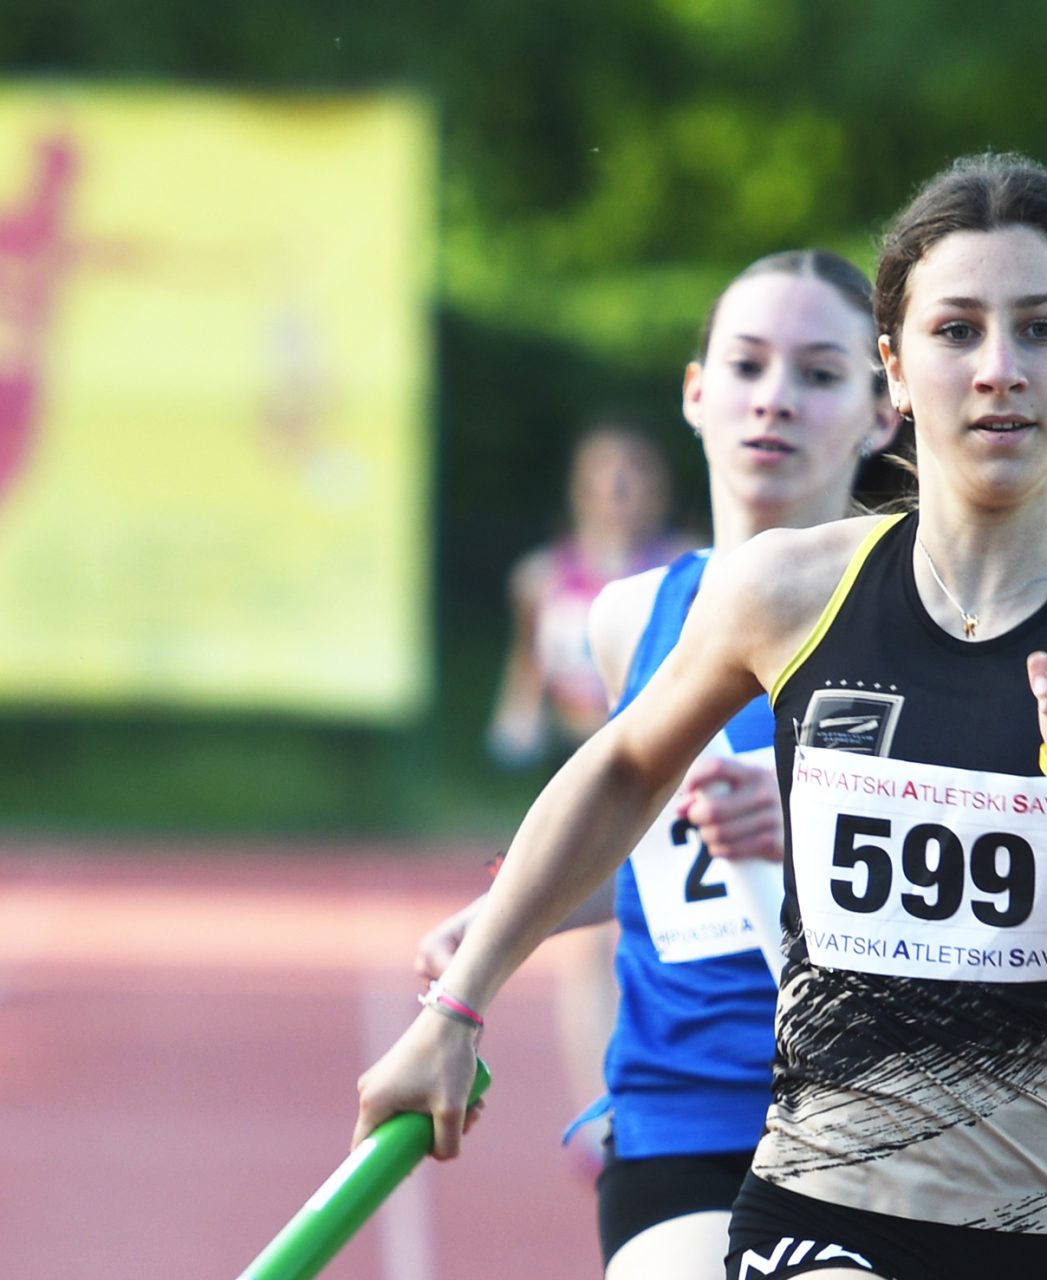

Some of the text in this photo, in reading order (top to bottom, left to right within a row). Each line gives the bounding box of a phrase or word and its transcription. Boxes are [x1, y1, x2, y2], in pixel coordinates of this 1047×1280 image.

[796, 762, 897, 797] HRVATSKI
[902, 780, 1007, 812] ATLETSKI
[829, 812, 1036, 929] 599
[804, 928, 887, 958] RVATSKI
[892, 939, 1003, 967] ATLETSKI
